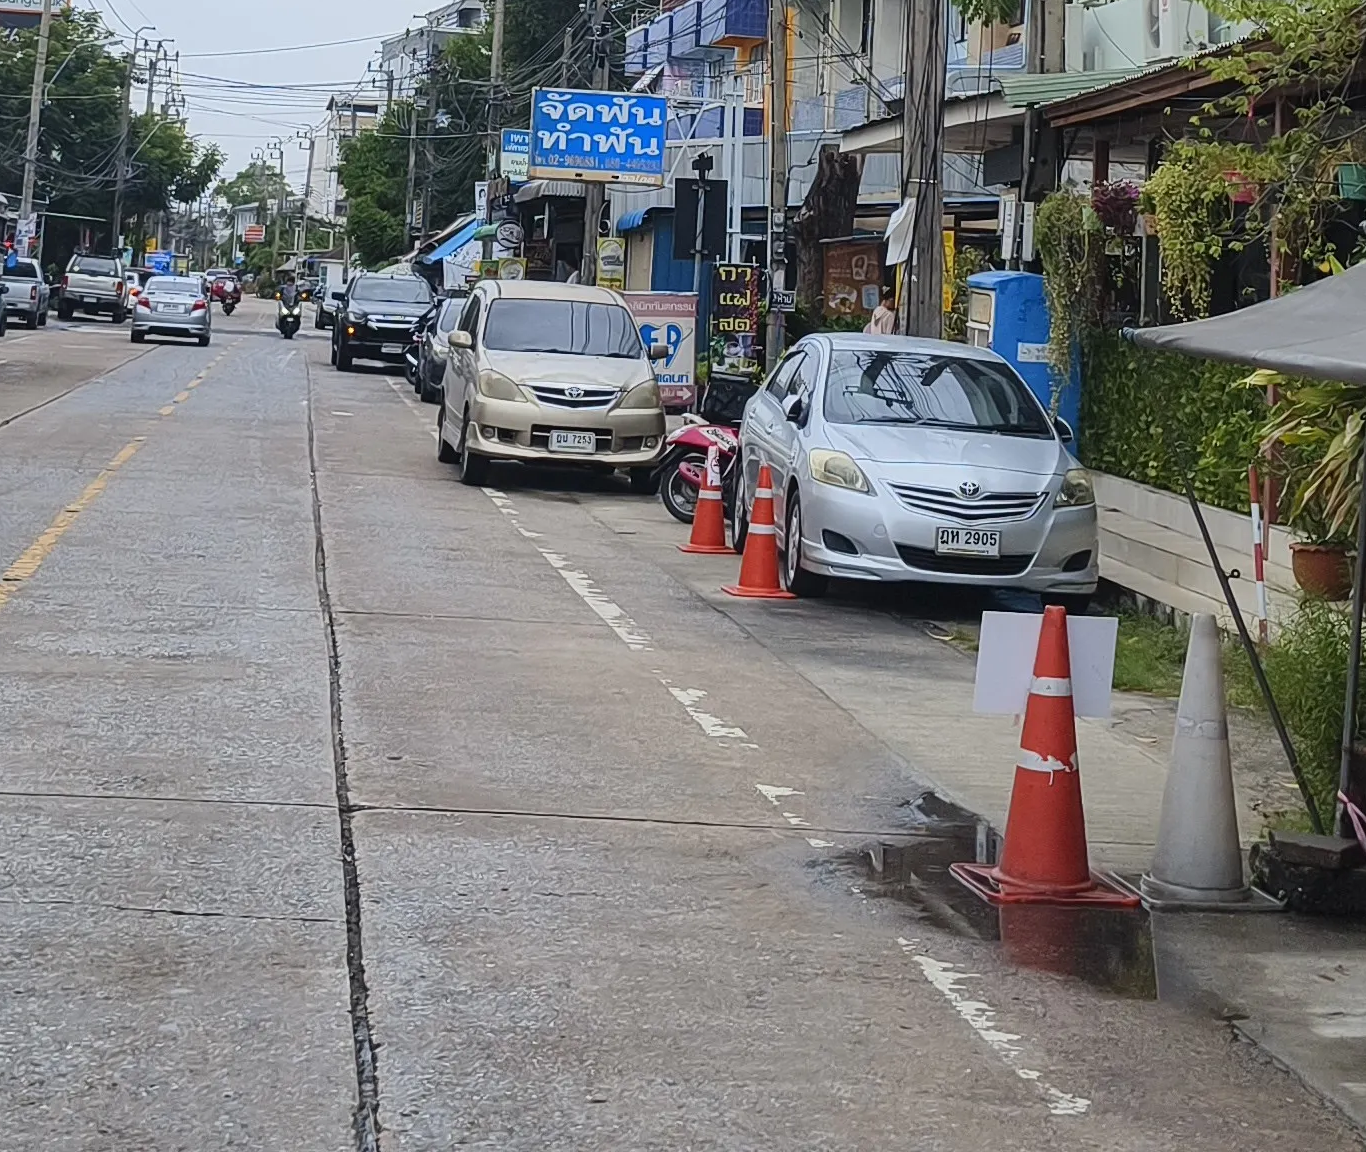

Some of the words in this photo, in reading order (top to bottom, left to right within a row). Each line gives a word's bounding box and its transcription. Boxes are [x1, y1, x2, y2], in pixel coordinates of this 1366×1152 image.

[538, 93, 662, 126] จัดฟัน
[537, 122, 660, 156] ทำฟัน
[964, 531, 998, 547] 2905
